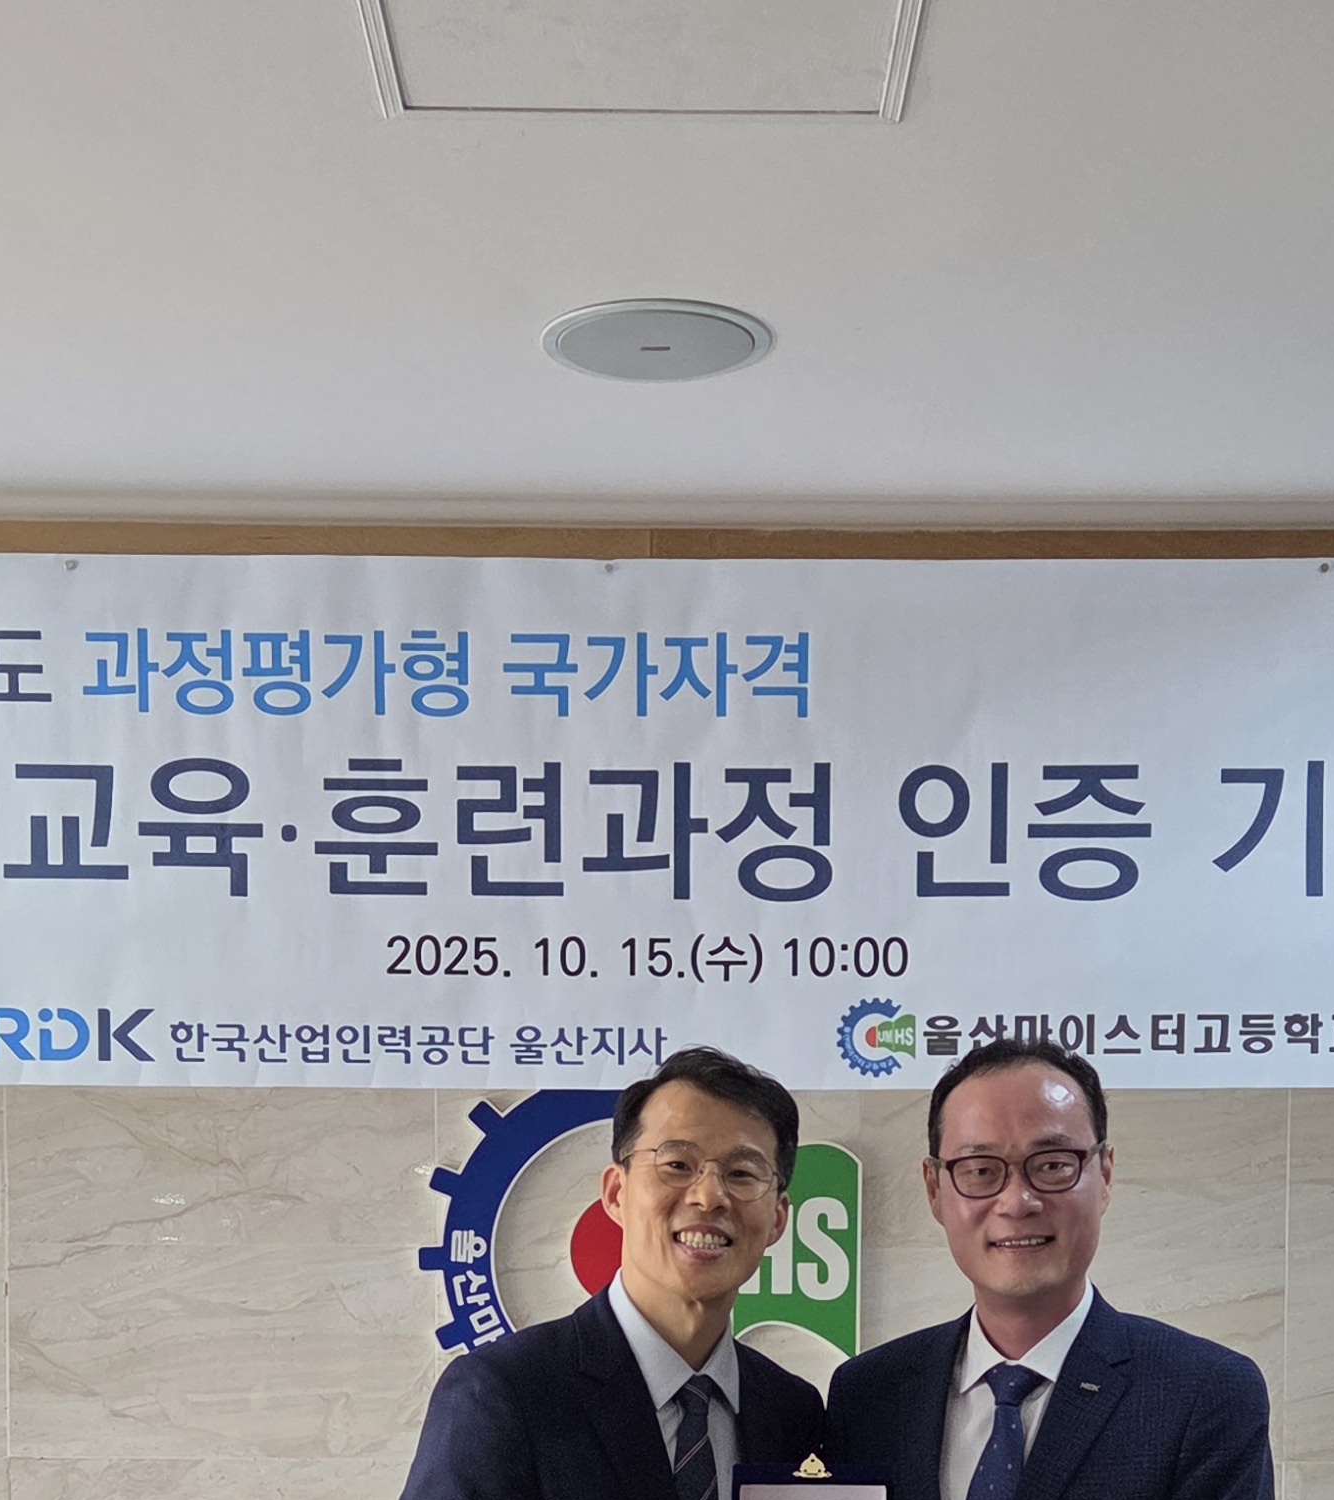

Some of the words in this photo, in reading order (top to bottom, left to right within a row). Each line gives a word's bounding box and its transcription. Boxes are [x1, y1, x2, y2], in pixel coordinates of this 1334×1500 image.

[82, 627, 469, 717] 과정평가형
[503, 631, 810, 718] 국가자격
[3, 757, 833, 902] 교육·훈련과정
[898, 761, 1152, 901] 인증
[386, 935, 511, 978] 2025.
[534, 936, 598, 978] 10.
[621, 933, 764, 983] 15.(수)
[783, 936, 909, 977] 10:00
[170, 1021, 495, 1065] 한국산업인력공단
[509, 1025, 668, 1065] 울산지사
